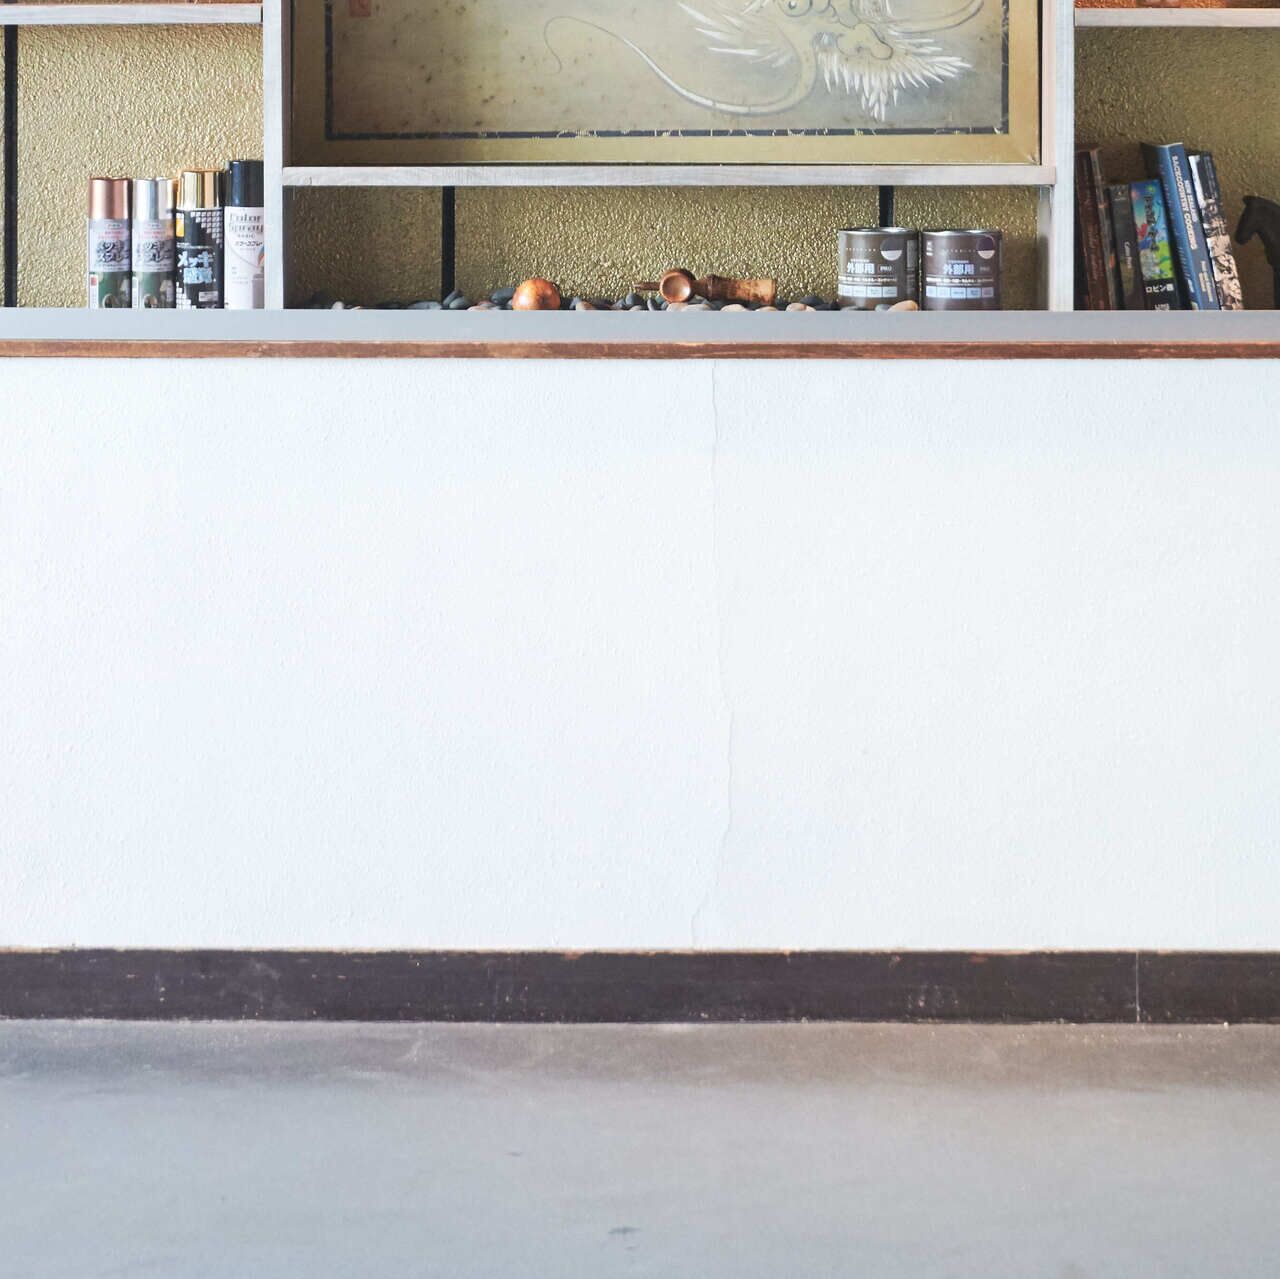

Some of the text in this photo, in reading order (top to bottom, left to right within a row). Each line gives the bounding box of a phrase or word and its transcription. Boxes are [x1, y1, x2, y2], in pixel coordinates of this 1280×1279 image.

[847, 262, 875, 275] 外部用
[944, 263, 975, 275] 外部用
